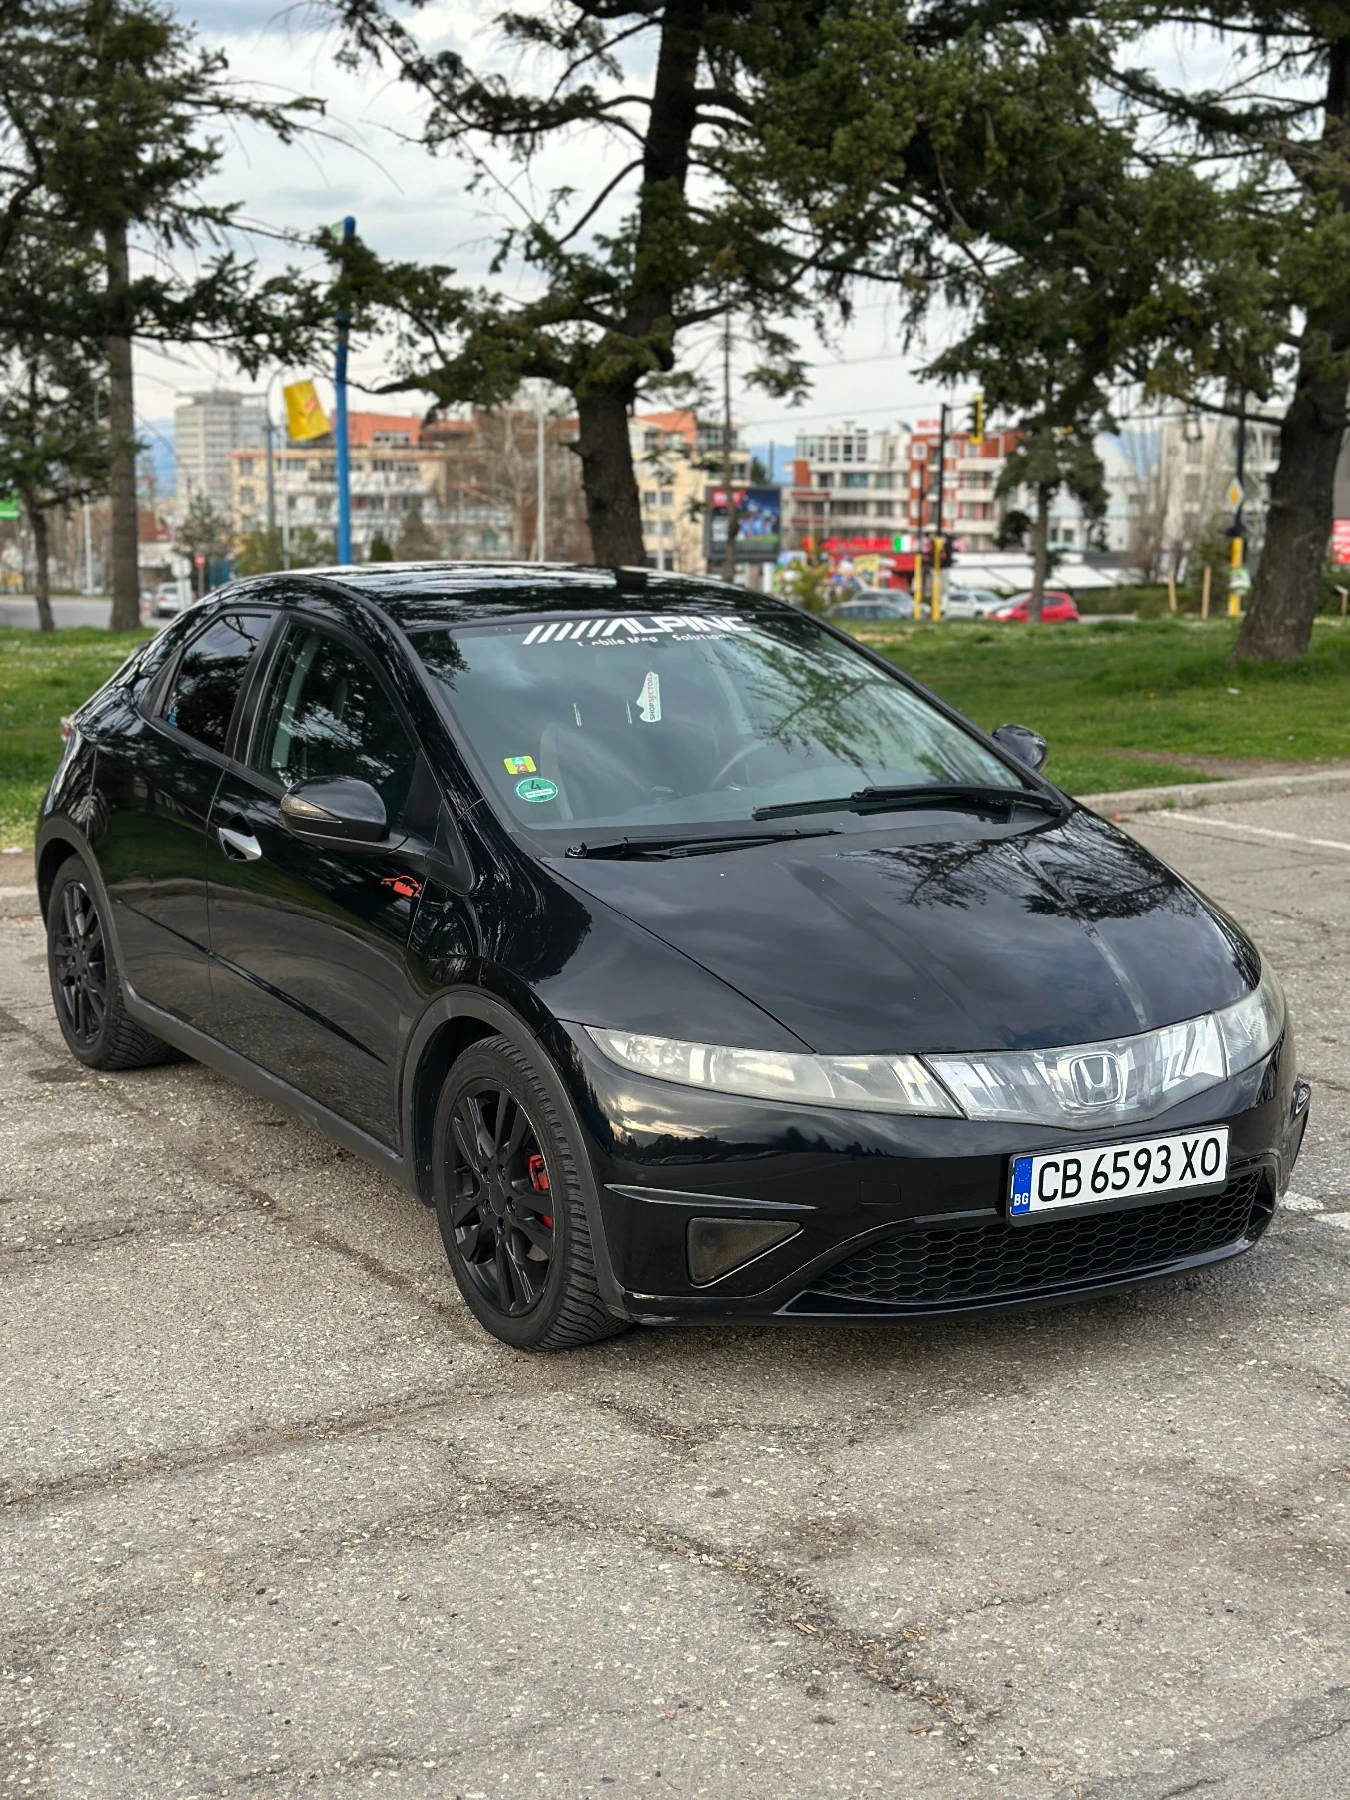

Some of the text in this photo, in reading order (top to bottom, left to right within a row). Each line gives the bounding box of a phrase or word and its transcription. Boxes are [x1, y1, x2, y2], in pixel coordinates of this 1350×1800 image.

[1037, 1137, 1221, 1202] CB 6593 XO
[1014, 1192, 1029, 1206] BG
